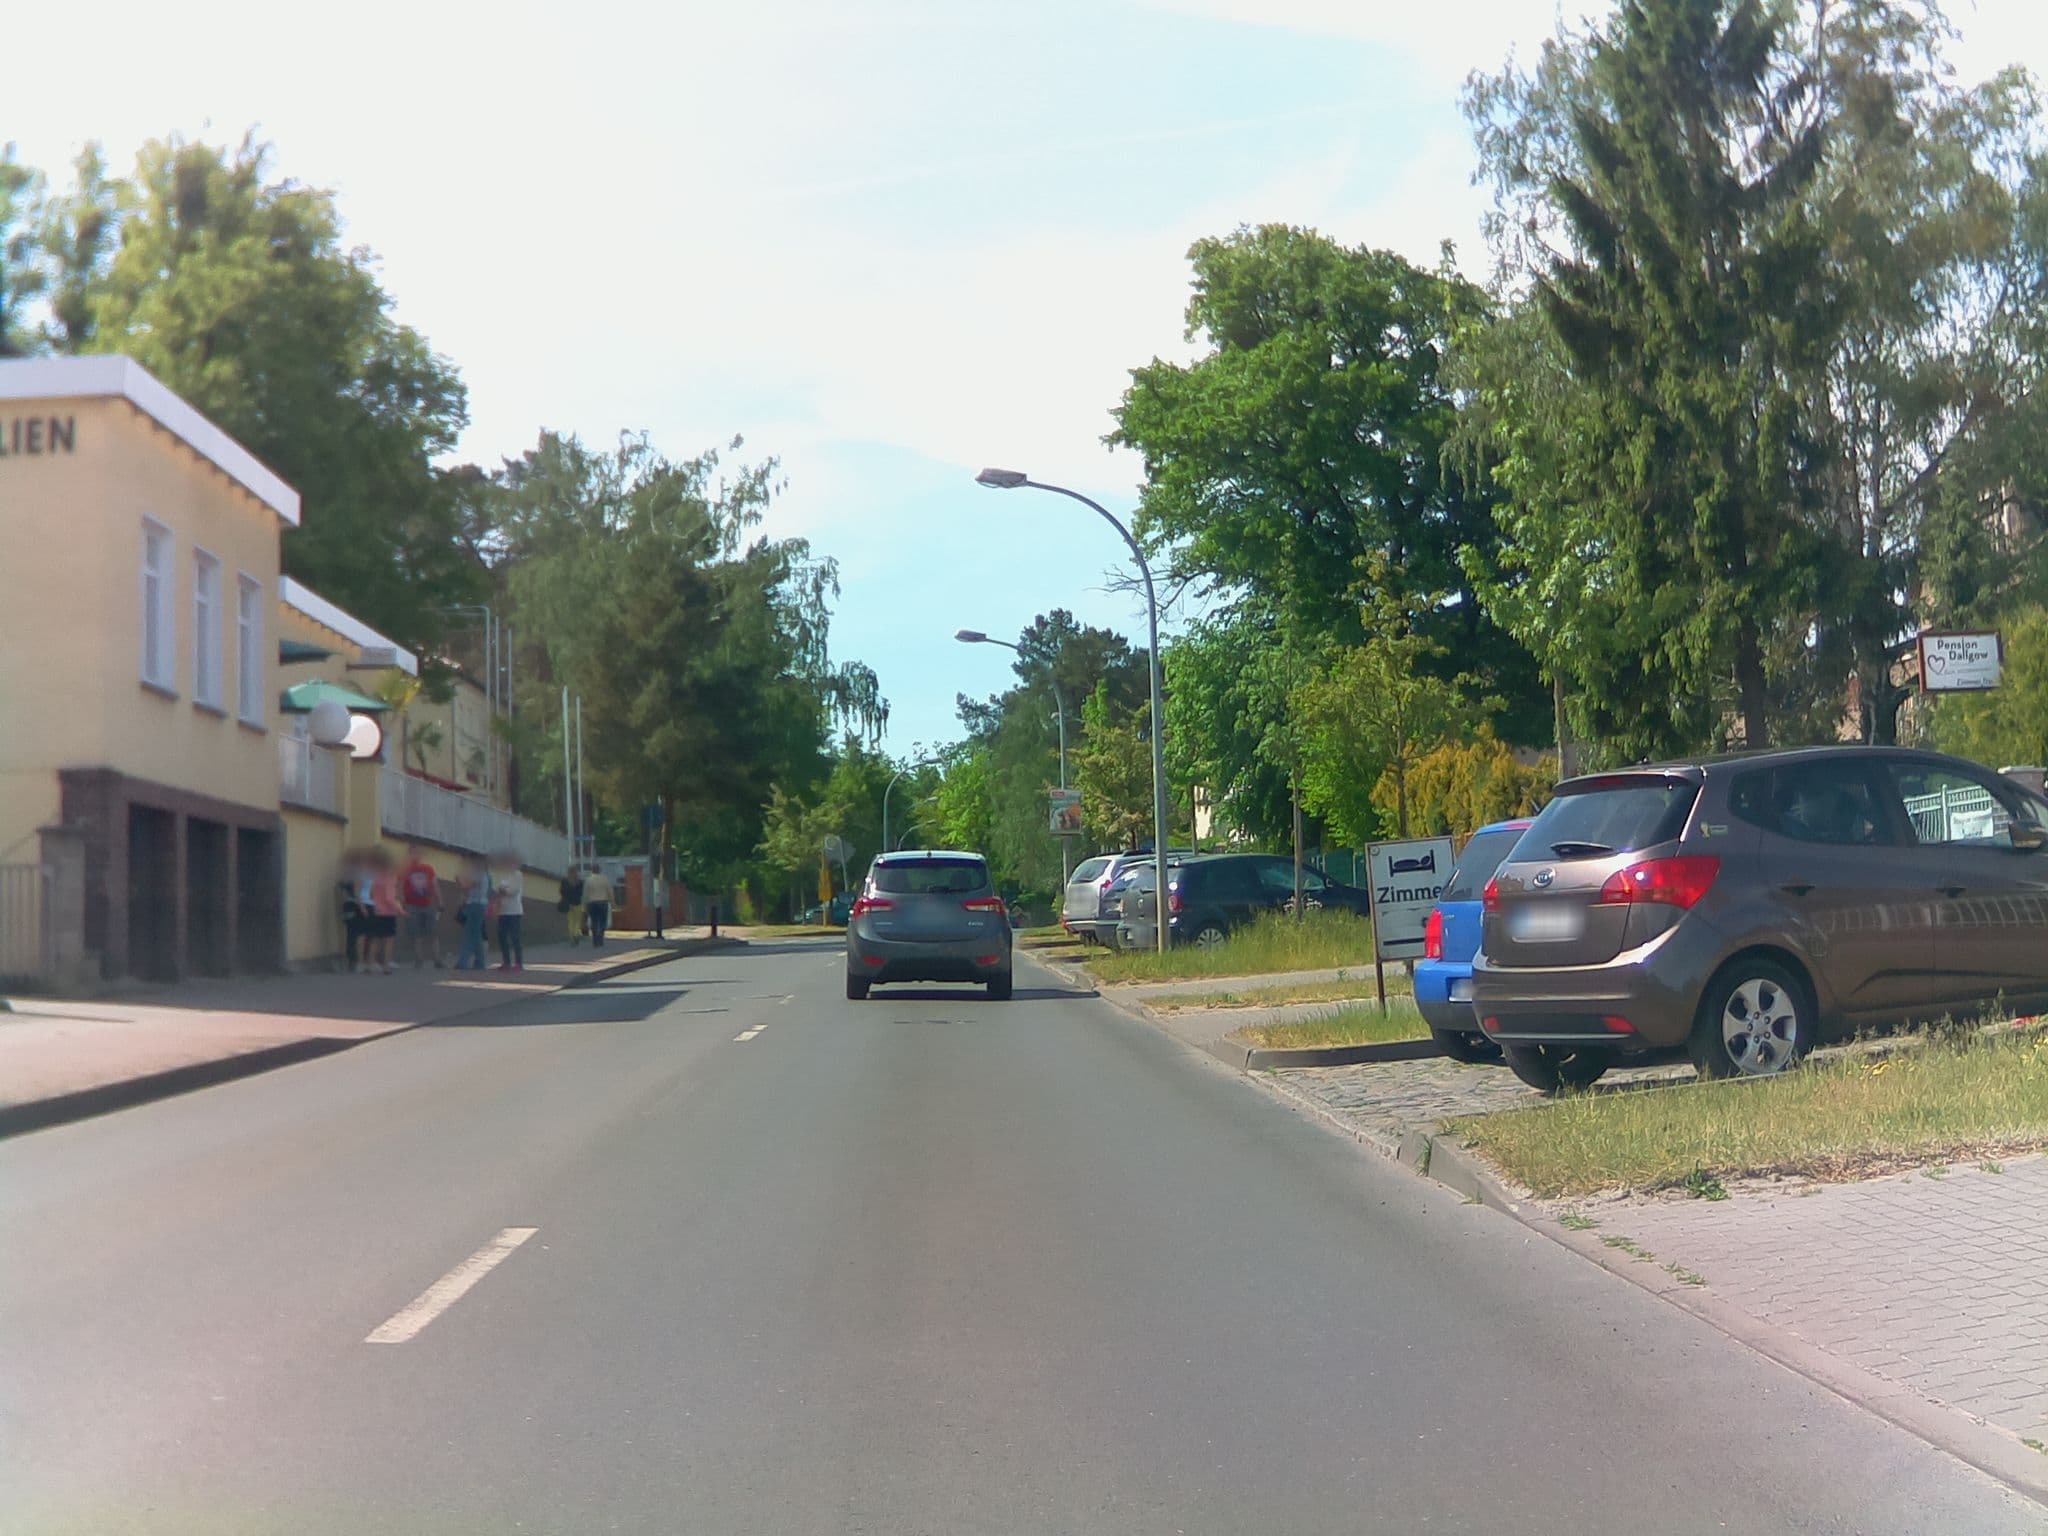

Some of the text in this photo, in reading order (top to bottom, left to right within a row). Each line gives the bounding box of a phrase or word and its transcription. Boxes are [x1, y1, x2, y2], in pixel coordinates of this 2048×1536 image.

[1937, 639, 1978, 650] Pension
[1949, 650, 1988, 663] Dallgow
[1377, 885, 1443, 904] Zimme
